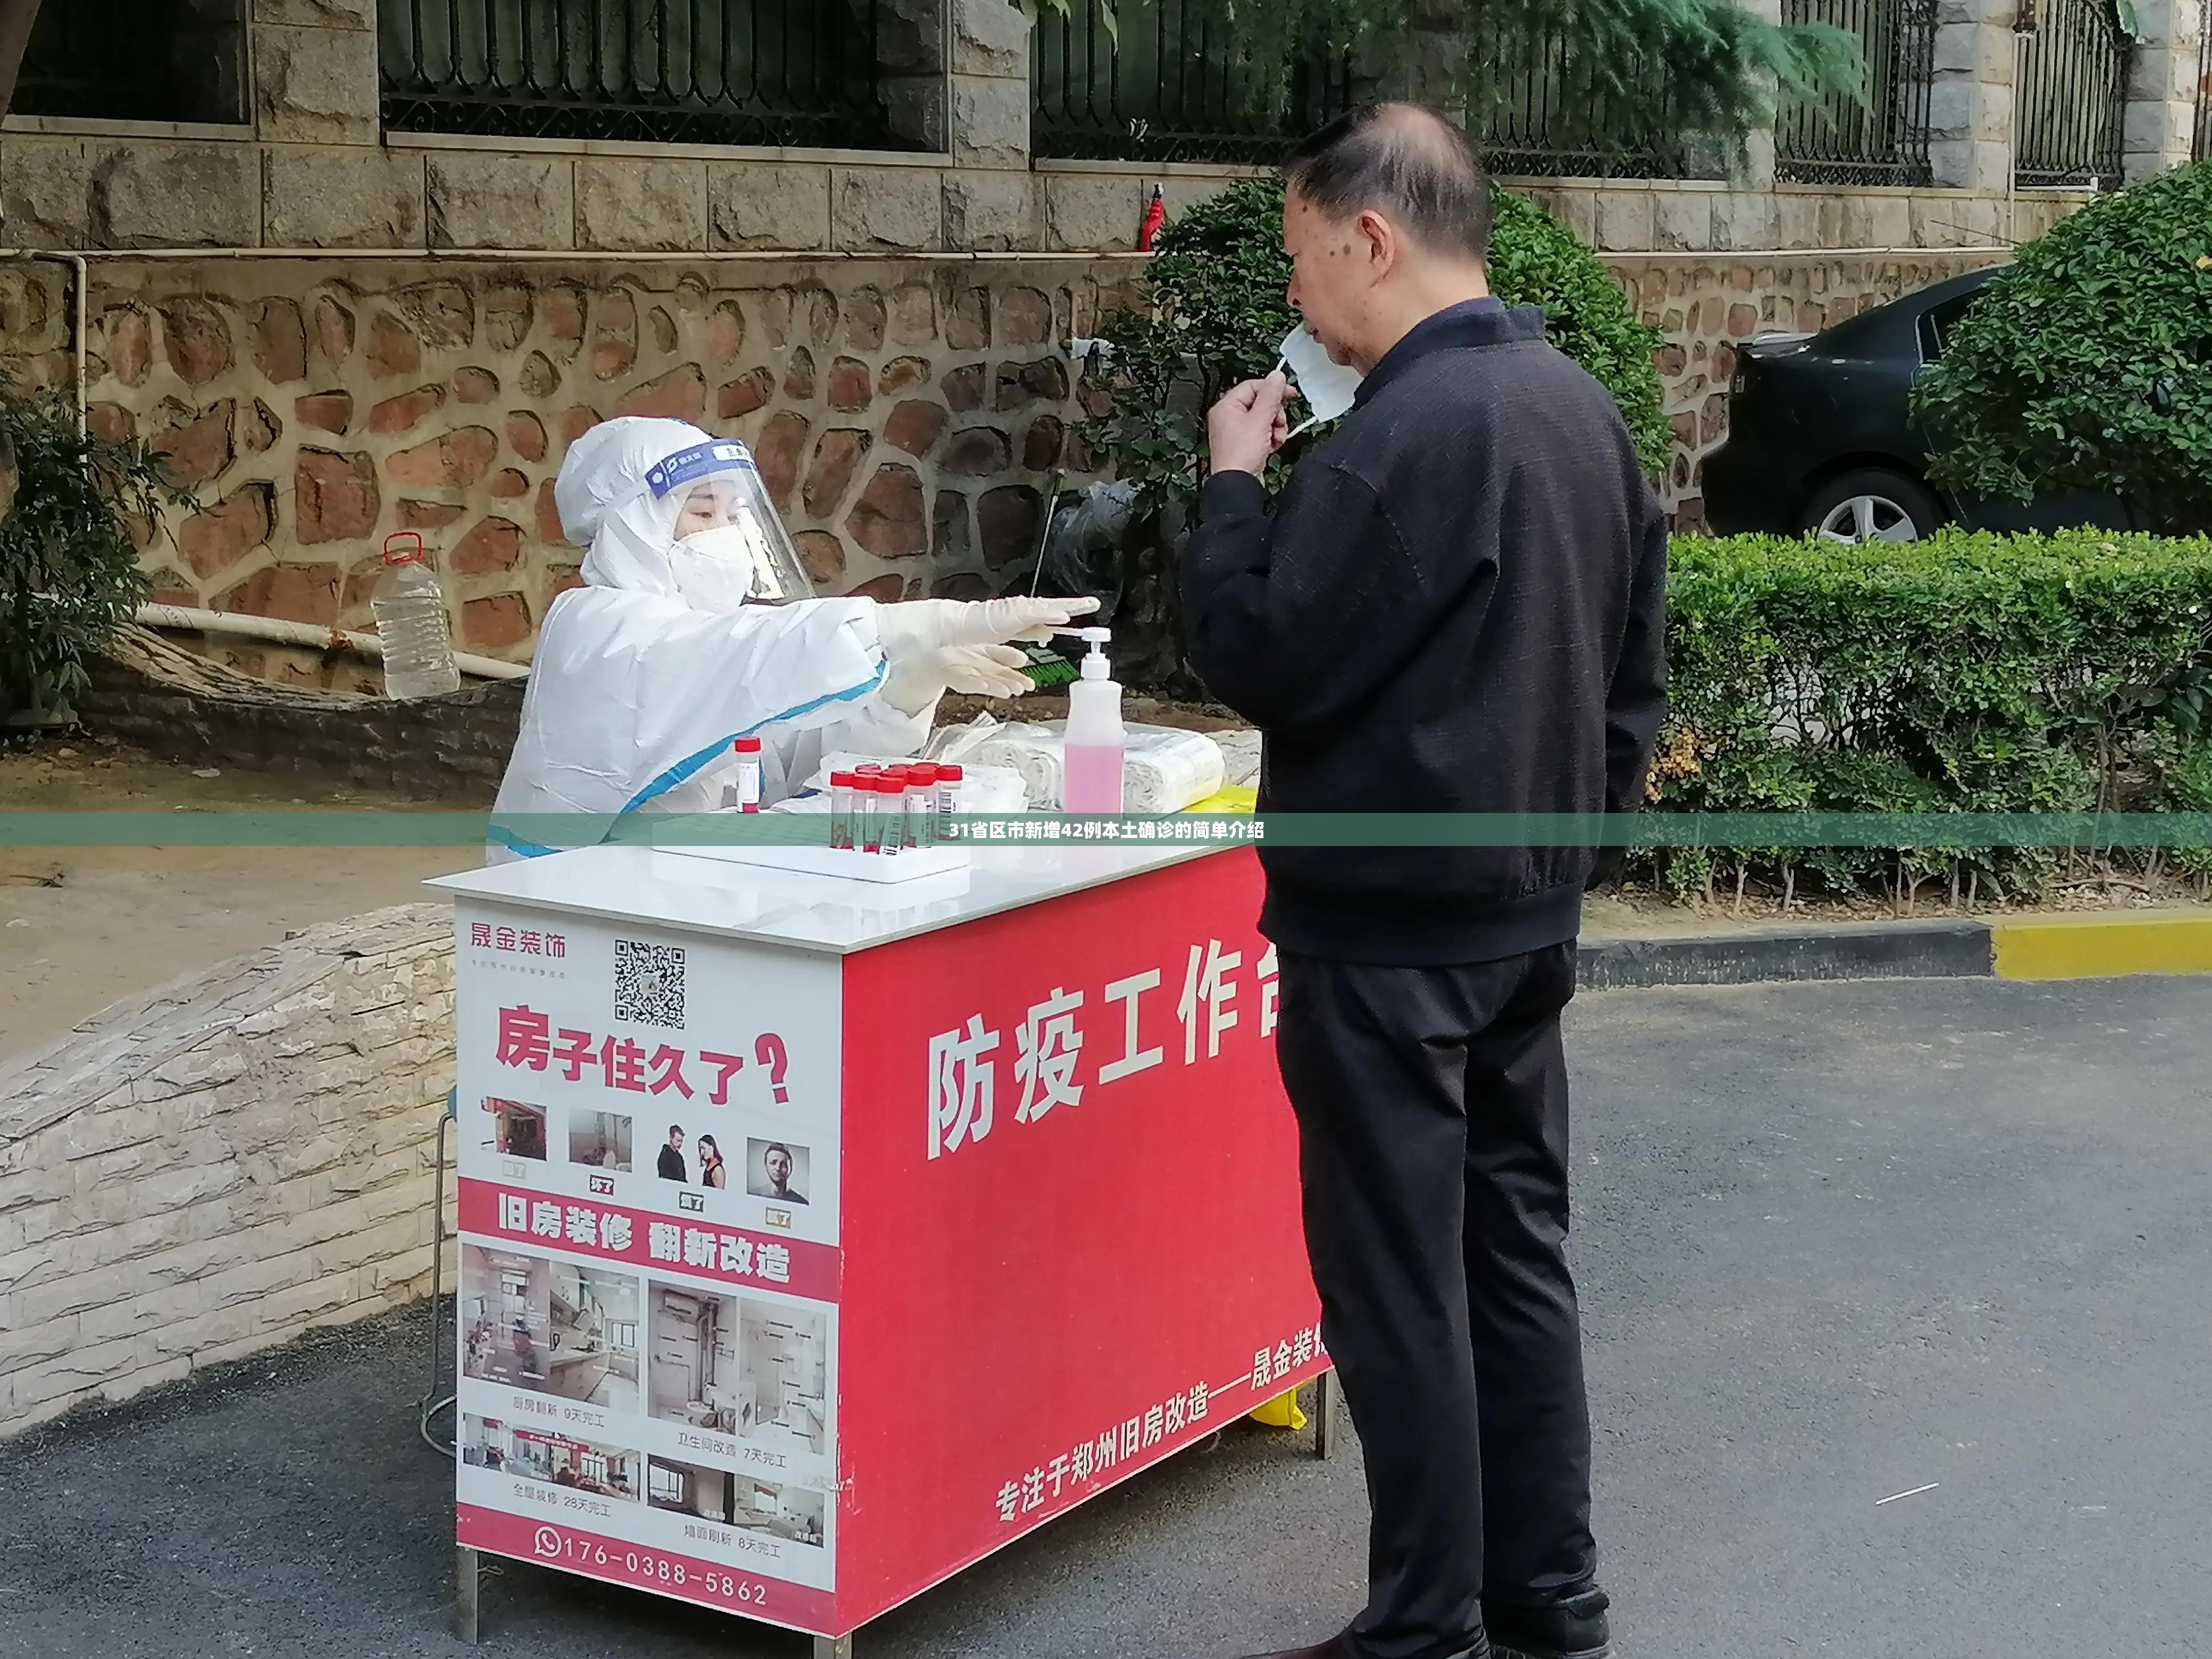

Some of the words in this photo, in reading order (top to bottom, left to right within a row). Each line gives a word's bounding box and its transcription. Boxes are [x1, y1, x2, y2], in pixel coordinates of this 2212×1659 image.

[471, 922, 566, 958] 晟金装饰
[499, 1192, 633, 1252] 旧房装修
[649, 1221, 790, 1283] 翻新改造
[678, 1431, 737, 1457] 卫生间改造
[744, 1448, 786, 1468] 7天完工
[738, 1536, 781, 1558] 8天完工
[563, 1537, 768, 1607] 176-0388-5862
